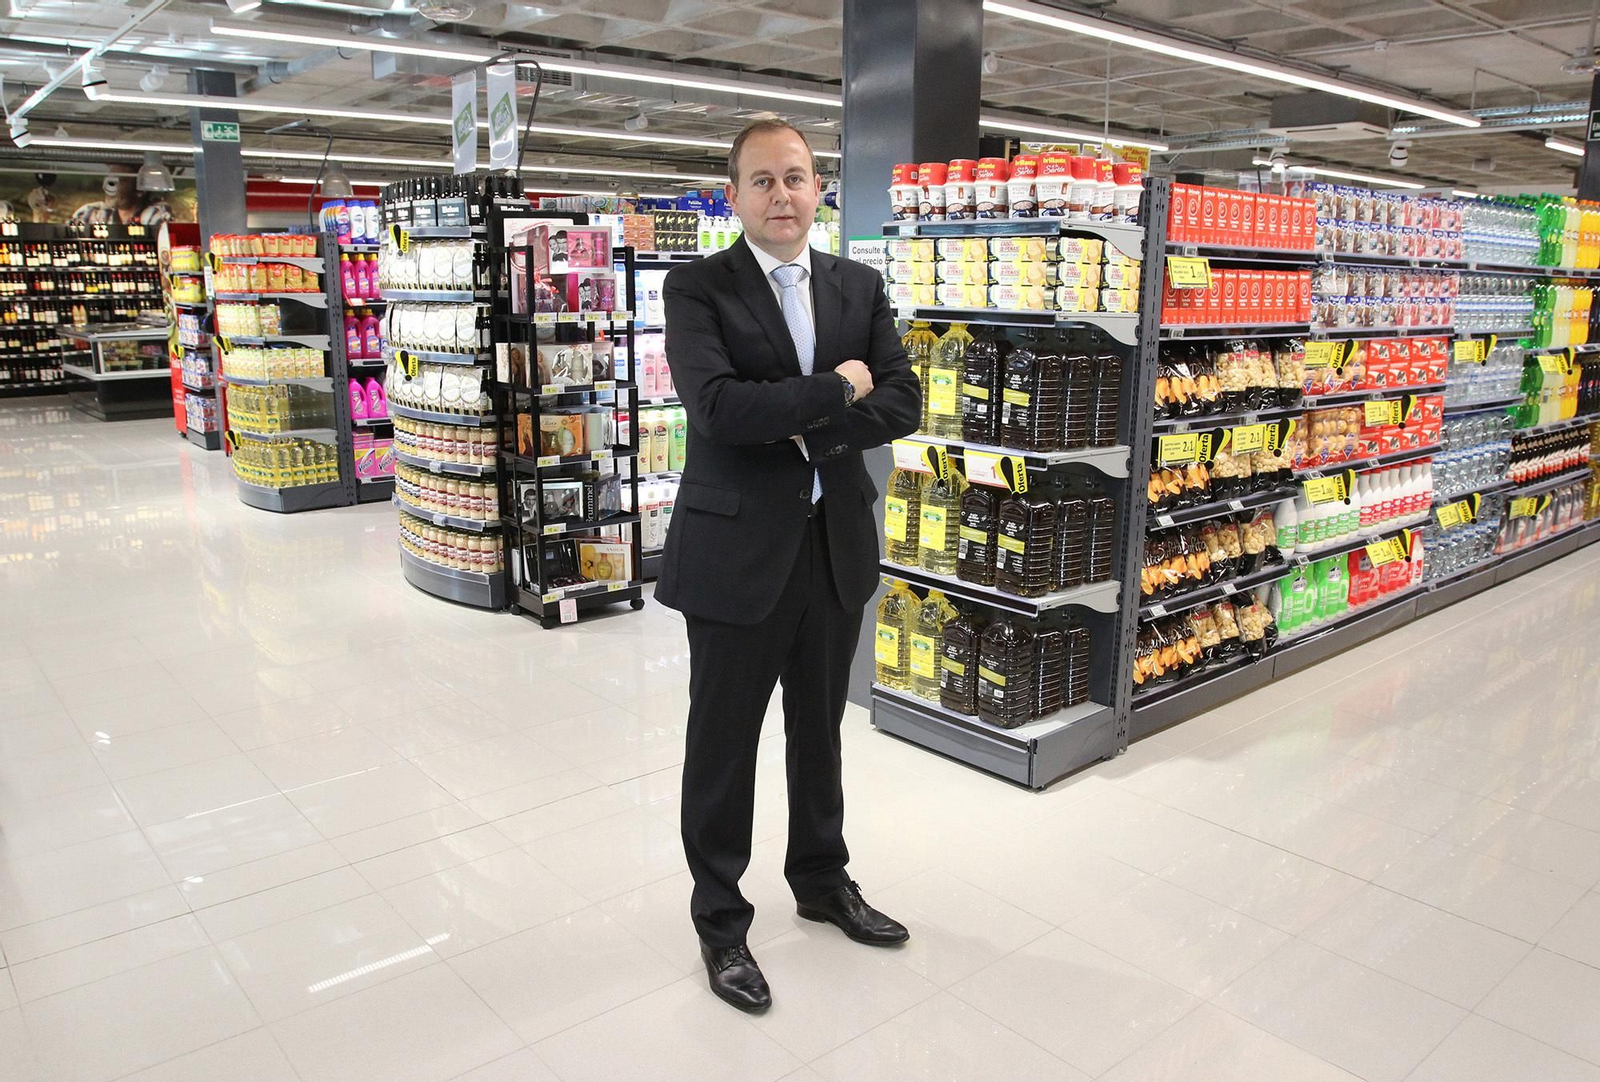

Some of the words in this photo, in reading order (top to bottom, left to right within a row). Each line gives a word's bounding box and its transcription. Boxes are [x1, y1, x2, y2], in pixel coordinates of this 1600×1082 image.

[852, 246, 881, 254] Consulte
[1332, 344, 1344, 369] Oferta
[1199, 435, 1209, 462] Oferta
[1268, 424, 1276, 451] Oferta
[1460, 501, 1470, 521] Oferta
[1392, 538, 1404, 560] Oferta
